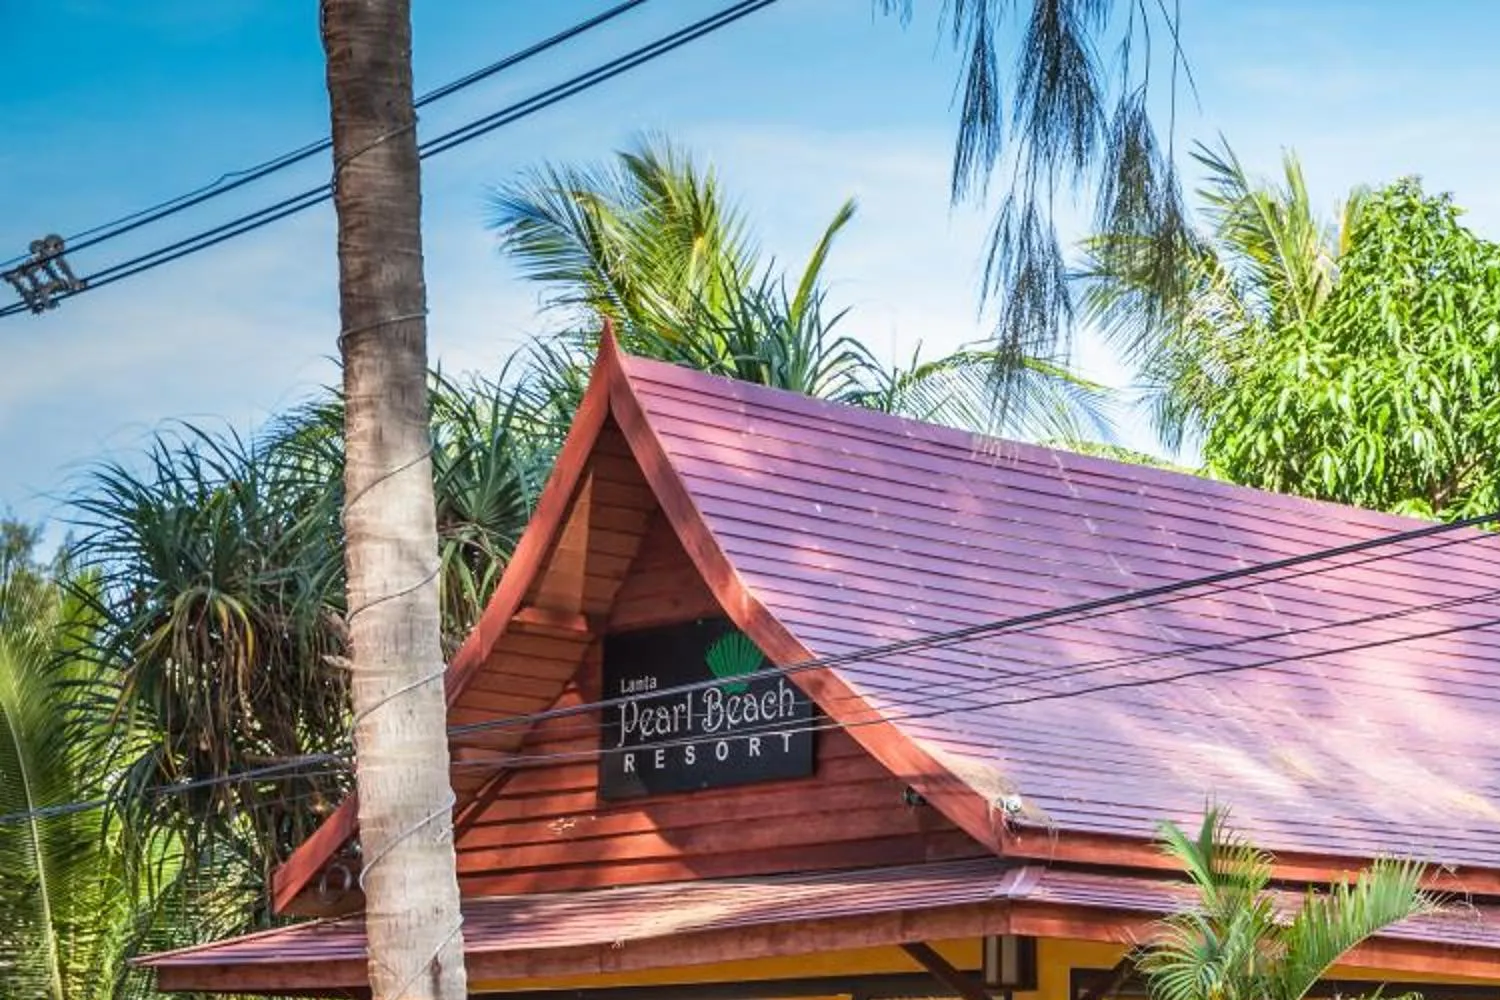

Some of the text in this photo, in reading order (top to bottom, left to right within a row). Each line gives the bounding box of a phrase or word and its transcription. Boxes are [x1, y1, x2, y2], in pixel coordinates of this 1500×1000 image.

[620, 675, 657, 694] Lanta
[617, 678, 795, 748] Pearl Beach
[623, 731, 794, 773] RESORT
